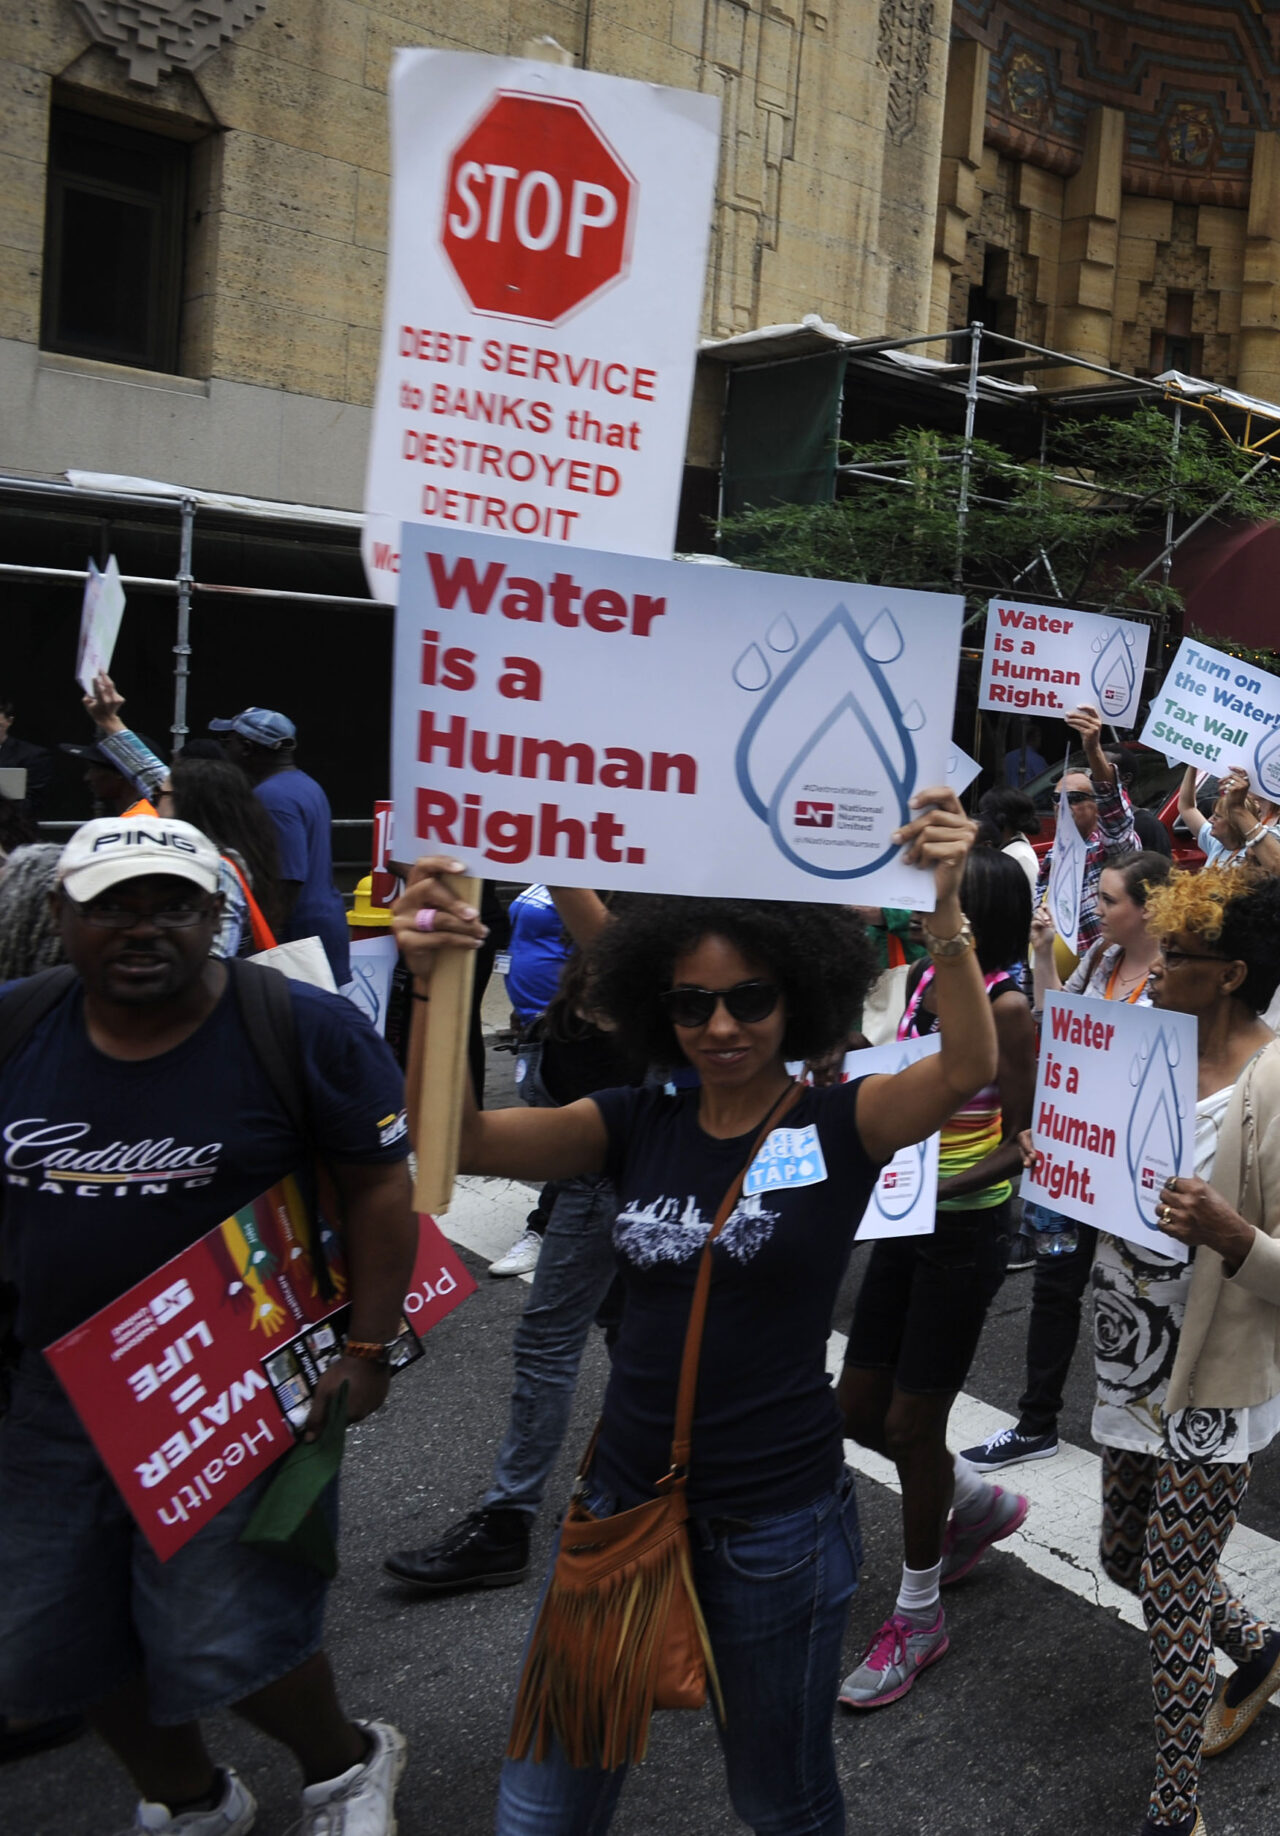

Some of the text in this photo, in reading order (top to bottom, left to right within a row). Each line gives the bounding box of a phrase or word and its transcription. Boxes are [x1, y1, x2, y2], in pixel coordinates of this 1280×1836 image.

[449, 160, 618, 258] STOP
[400, 325, 657, 402] DEBT SERVICE
[400, 380, 641, 451] to BANKS that
[402, 429, 621, 497] DESTROYED
[422, 484, 580, 541] DETROIT
[425, 552, 667, 637] Water
[994, 633, 1035, 655] is a
[998, 608, 1073, 634] Water
[421, 630, 543, 701] is a
[992, 659, 1080, 686] Human
[1174, 671, 1207, 697] the
[1186, 648, 1262, 695] Turn on
[989, 684, 1064, 708] Right.
[1151, 721, 1222, 763] Street!
[1163, 698, 1249, 748] Tax Wall
[418, 709, 697, 794] Human
[415, 787, 646, 864] Right.
[837, 822, 873, 831] United
[838, 803, 884, 814] National
[838, 812, 874, 822] Nurses
[92, 830, 197, 855] PING
[1051, 1006, 1116, 1051] Water
[1045, 1053, 1079, 1094] is a
[3, 1117, 223, 1171] Cadillac
[1037, 1102, 1116, 1158] Human
[7, 1174, 218, 1197] RACING
[751, 1164, 797, 1186] TAP
[1030, 1150, 1095, 1205] Right.
[278, 1274, 303, 1320] Healthcare
[128, 1320, 215, 1402] LIFE
[293, 1341, 306, 1354] MI
[157, 1266, 458, 1526] Pro Health
[134, 1369, 270, 1489] WATER
